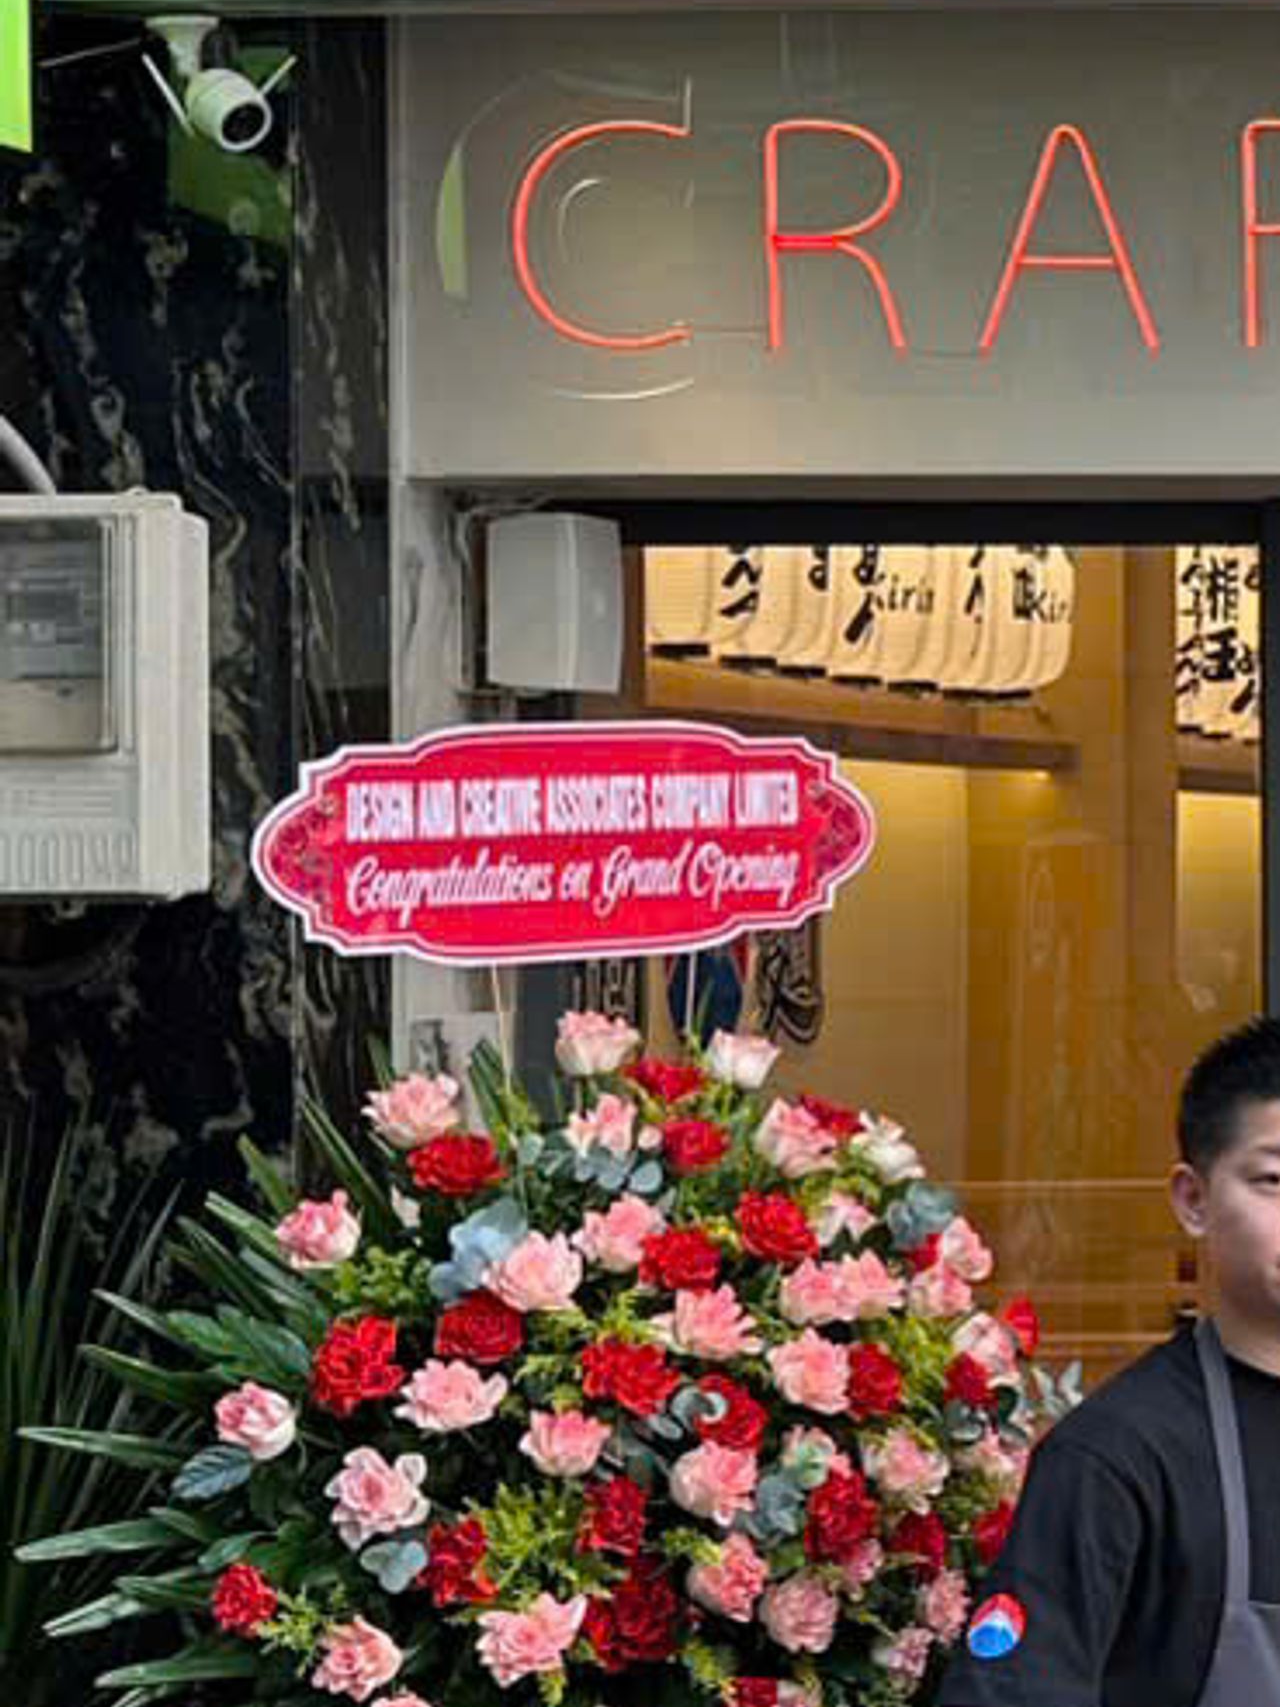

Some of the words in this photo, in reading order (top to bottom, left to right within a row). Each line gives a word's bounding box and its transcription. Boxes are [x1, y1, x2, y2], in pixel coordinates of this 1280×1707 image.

[346, 780, 414, 843] DESIGN
[418, 779, 456, 840] AND
[459, 777, 543, 838] CREATIVE
[546, 773, 647, 834] ASSOCIATES
[651, 772, 730, 830] COMPANY
[735, 769, 799, 827] LIMITED
[346, 847, 554, 929] Congratulations
[559, 860, 593, 901] on
[592, 839, 694, 917] Grand
[689, 840, 799, 912] Opening
